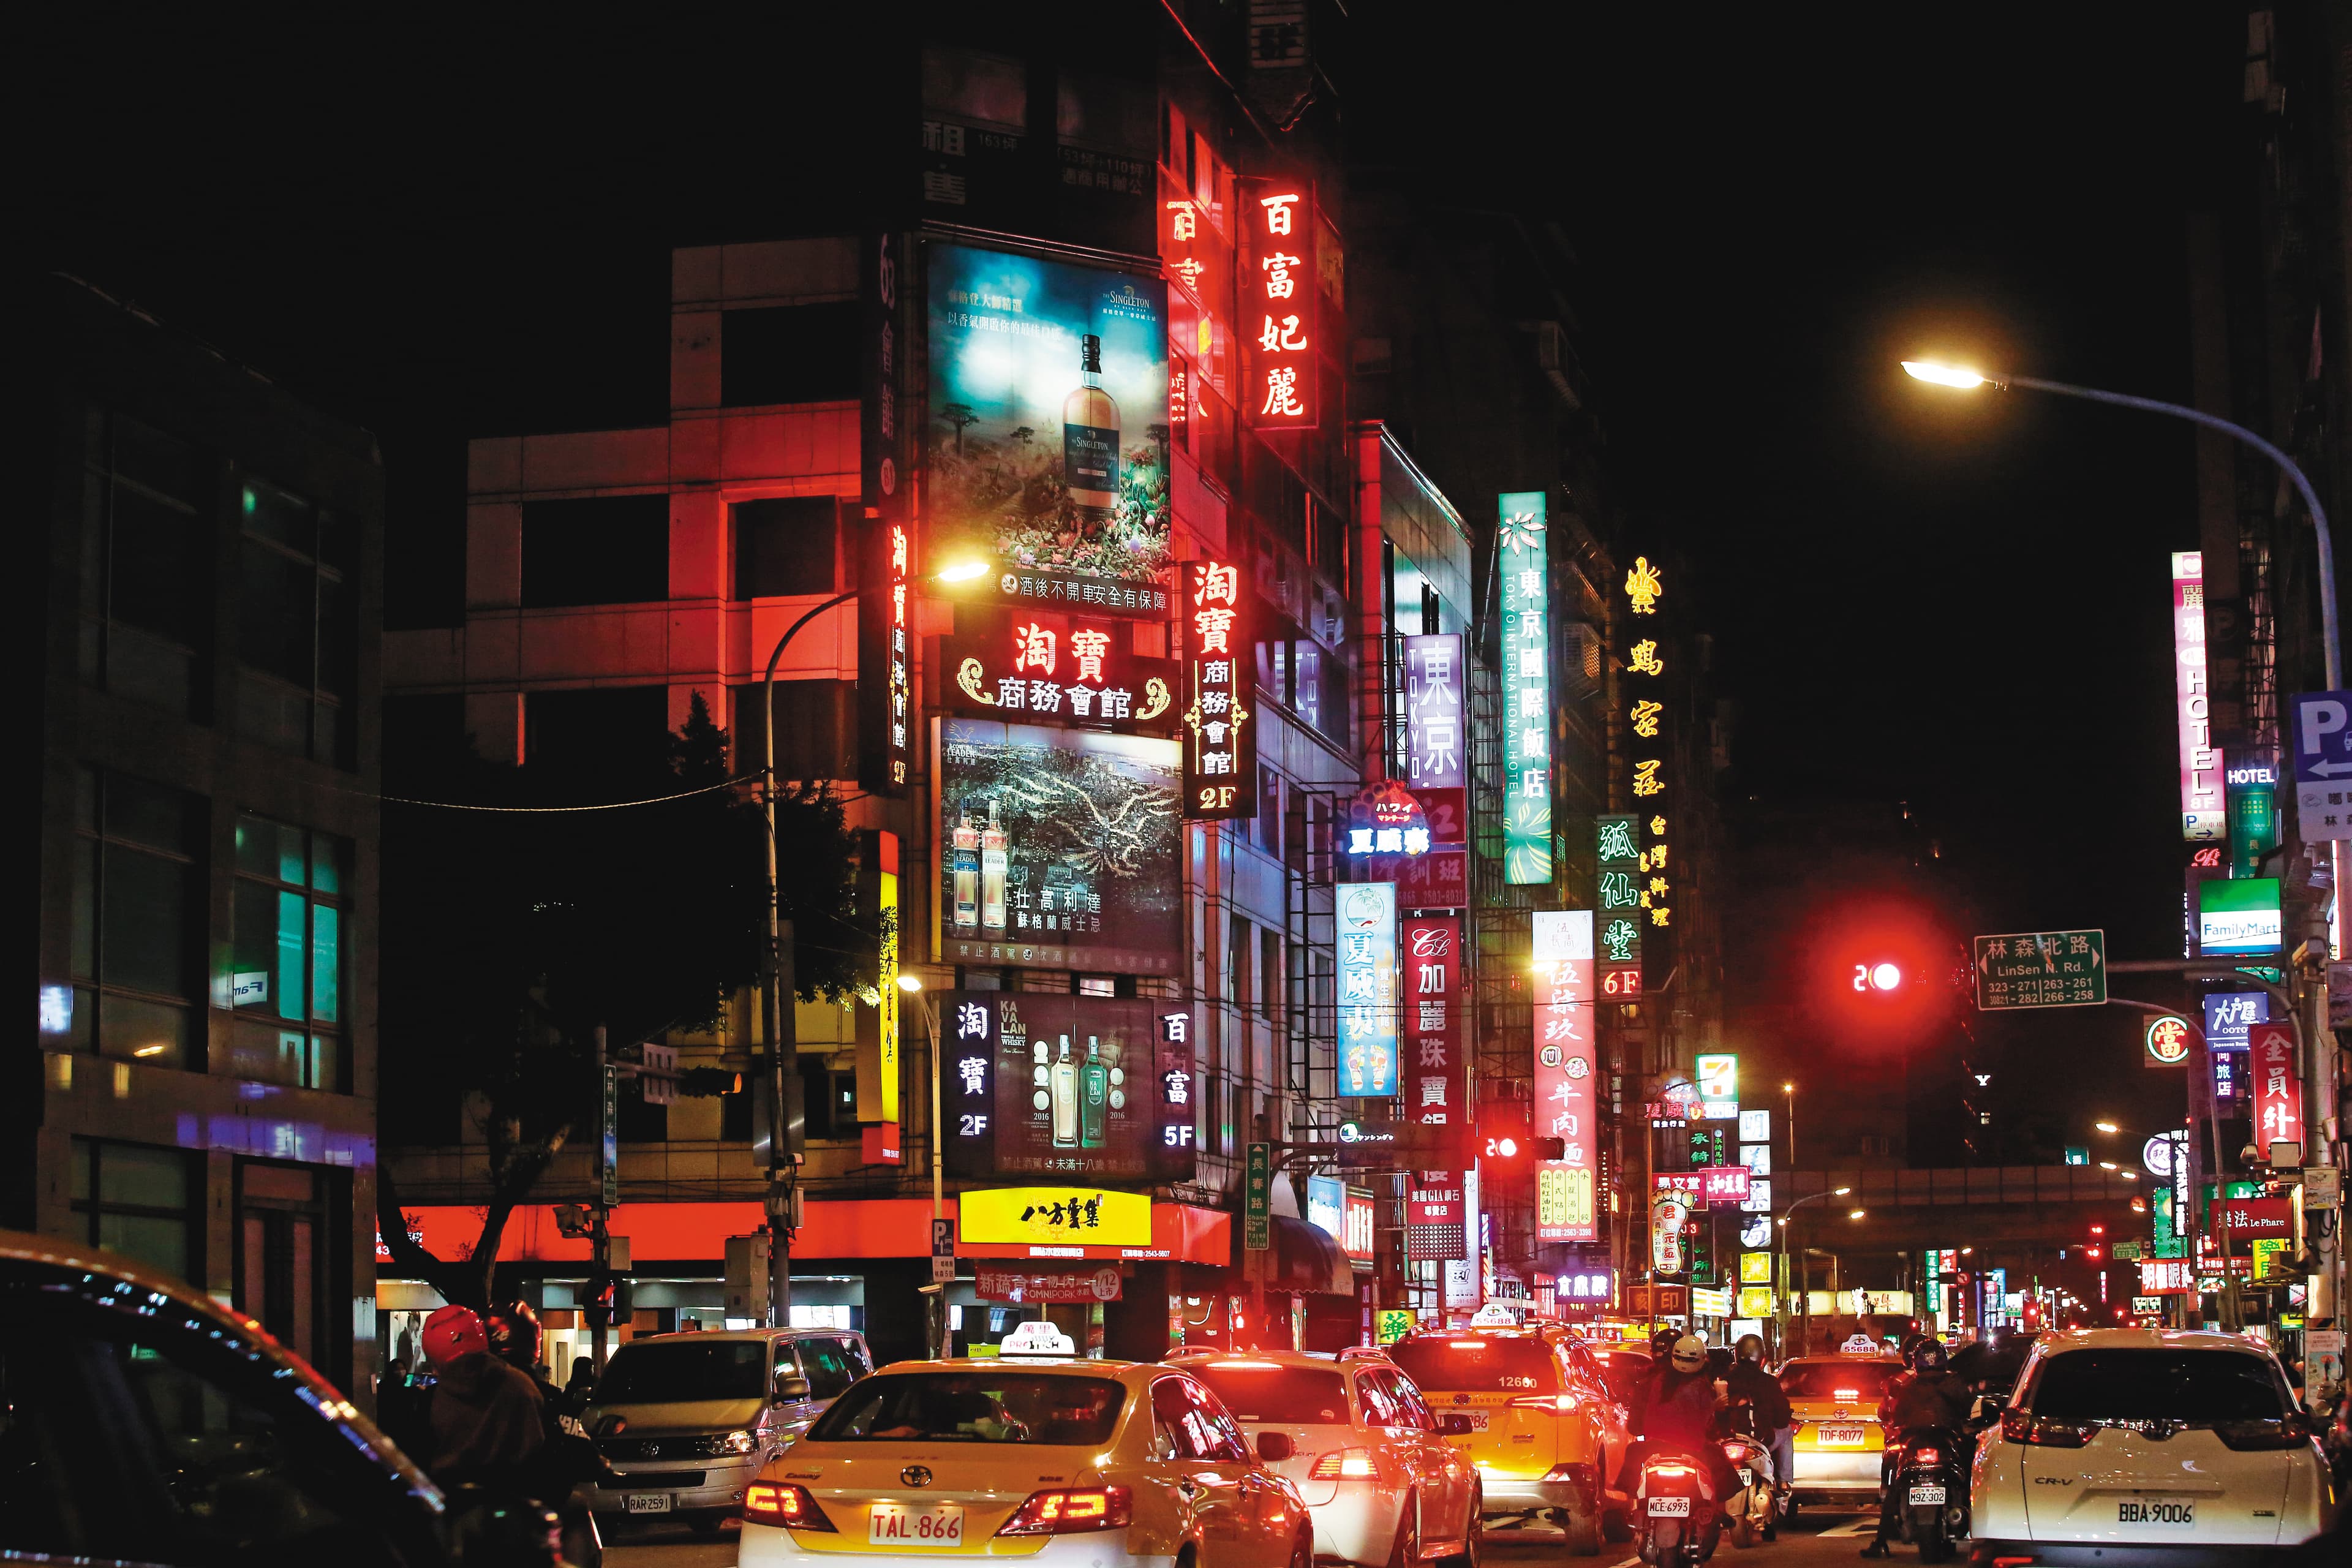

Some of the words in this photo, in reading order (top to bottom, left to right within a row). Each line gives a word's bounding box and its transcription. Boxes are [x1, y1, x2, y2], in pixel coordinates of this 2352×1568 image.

[1110, 290, 1150, 309] SINGLETON
[1257, 193, 1307, 417] 百富妃麗
[1505, 575, 1517, 624] TOKYO
[1015, 622, 1110, 684] 淘寶
[1507, 628, 1517, 748] INTERNATIONAL
[1518, 568, 1546, 799] 東京國際飯店
[995, 676, 1133, 720] 商務會館
[1419, 641, 1459, 775] 東京
[1202, 660, 1232, 775] 商務會館
[1409, 649, 1420, 779] TOKYO
[2185, 670, 2214, 796] HOTEL
[2299, 699, 2348, 755] P
[947, 748, 977, 758] LEADER
[1508, 751, 1519, 799] HOTEL
[2228, 769, 2275, 785] HOTEL
[1199, 786, 1237, 809] 2F
[1376, 802, 1412, 813] ハワイ
[2190, 797, 2215, 809] 8F
[2186, 815, 2197, 828] P
[1649, 815, 1670, 927] 台灣料理
[1016, 888, 1101, 914] 仕高利達
[1599, 821, 1638, 962] 狐仙堂
[1017, 910, 1101, 933] 蘇格蘭威士忌
[2204, 923, 2277, 938] FamilyMart
[1987, 935, 2090, 959] 林森北路
[1998, 965, 2040, 976] LinSen
[2046, 963, 2058, 973] N.
[2064, 962, 2084, 973] Rd.
[1604, 970, 1639, 995] 6F
[1988, 981, 2037, 992] 323-271
[2043, 978, 2093, 989] 263-261
[2044, 990, 2094, 1002] 266-258
[957, 1001, 989, 1095] 淘寶
[2155, 1021, 2185, 1058] 當
[1164, 1012, 1190, 1104] 百富
[2260, 1031, 2297, 1142] 金員外
[959, 1115, 987, 1136] 2F
[1034, 1112, 1049, 1121] 2016
[1164, 1125, 1193, 1147] 5F
[1251, 1158, 1264, 1209] 長春路
[934, 1222, 946, 1245] P
[2261, 1218, 2285, 1227] Phare
[2035, 1477, 2073, 1486] CR-V
